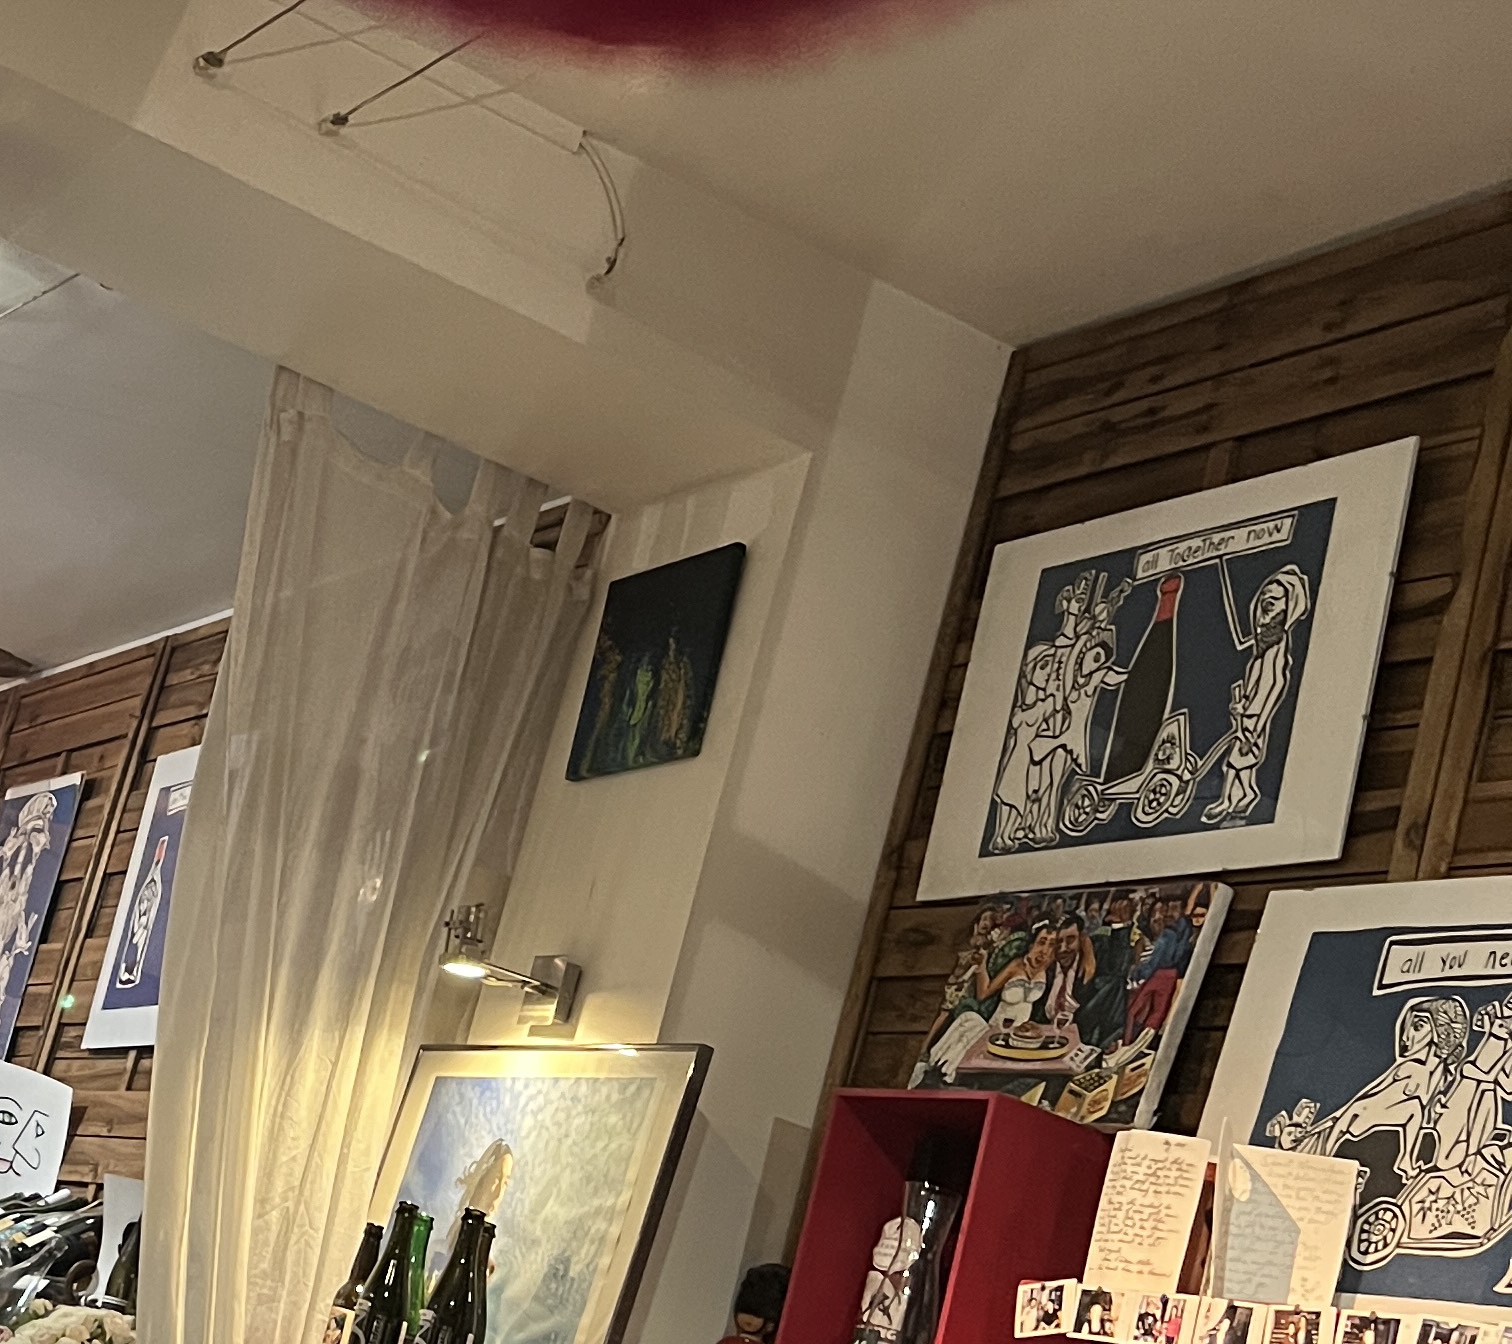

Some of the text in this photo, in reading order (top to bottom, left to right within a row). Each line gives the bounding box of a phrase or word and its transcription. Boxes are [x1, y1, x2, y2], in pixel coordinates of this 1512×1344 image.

[1141, 552, 1159, 574] all
[1400, 950, 1426, 974] all
[1484, 950, 1512, 970] ne
